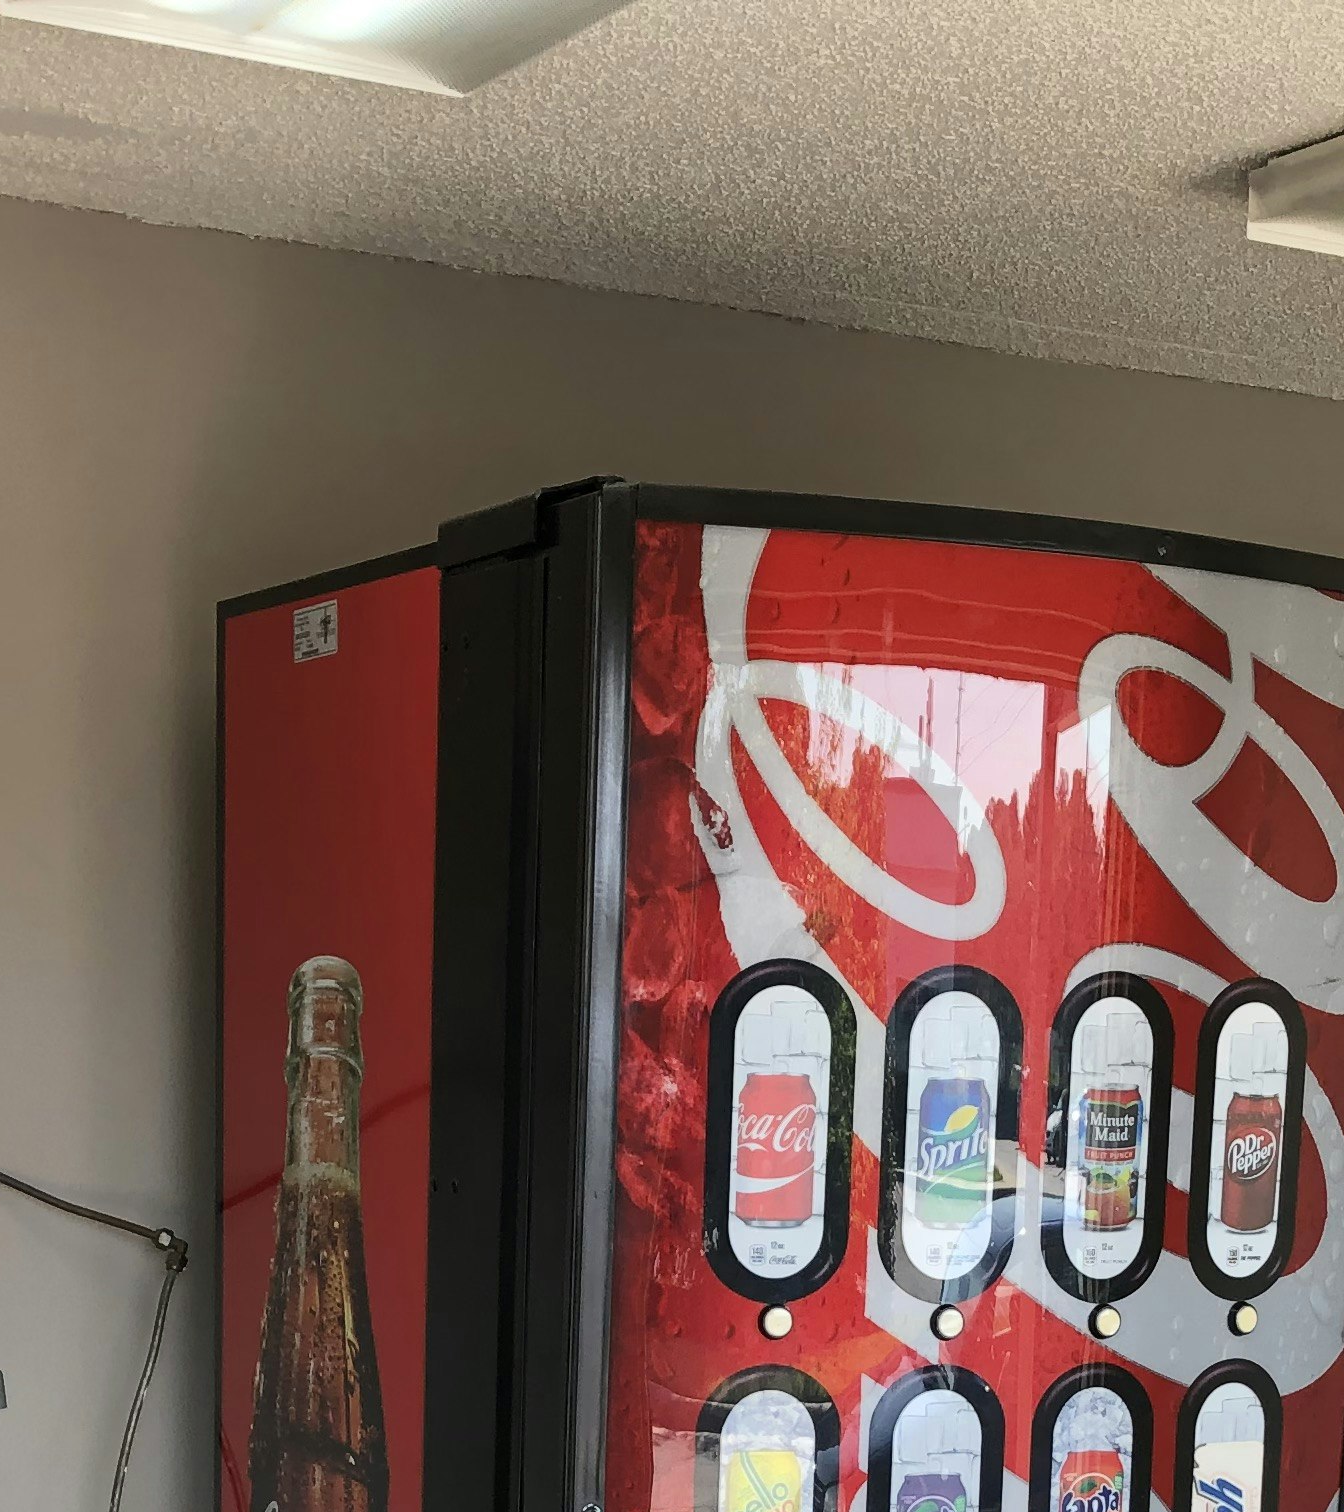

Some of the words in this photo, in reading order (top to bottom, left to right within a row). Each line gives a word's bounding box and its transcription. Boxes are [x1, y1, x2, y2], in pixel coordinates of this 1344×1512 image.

[1089, 1111, 1136, 1128] Minute
[1094, 1126, 1129, 1142] Maid
[1244, 1133, 1265, 1152] Dr
[1230, 1138, 1275, 1176] Pepper
